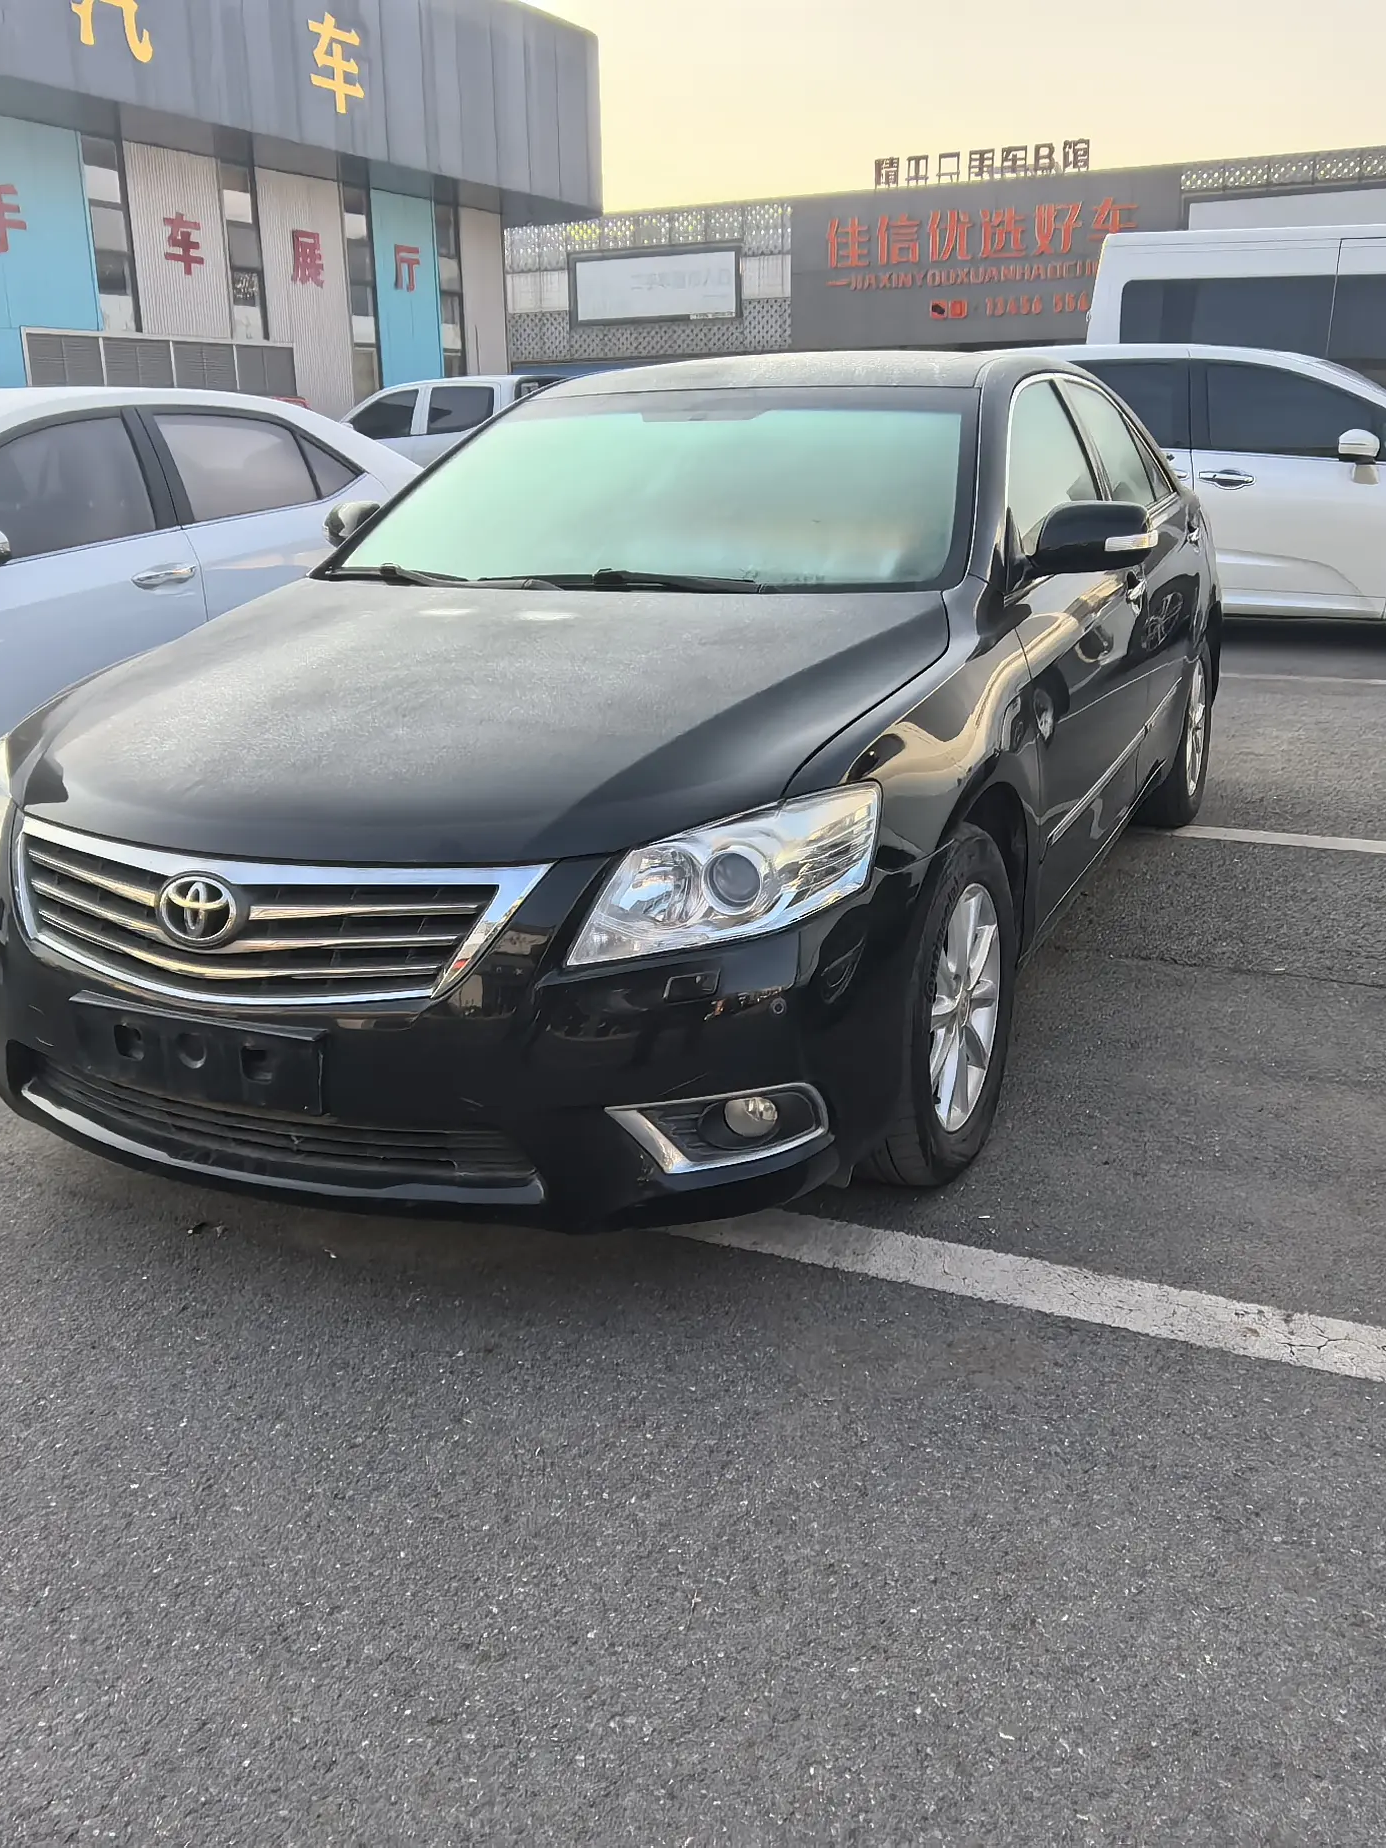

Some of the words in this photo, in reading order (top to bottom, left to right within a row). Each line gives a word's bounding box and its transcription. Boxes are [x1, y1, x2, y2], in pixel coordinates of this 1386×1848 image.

[826, 197, 1139, 269] 佳信优选好车
